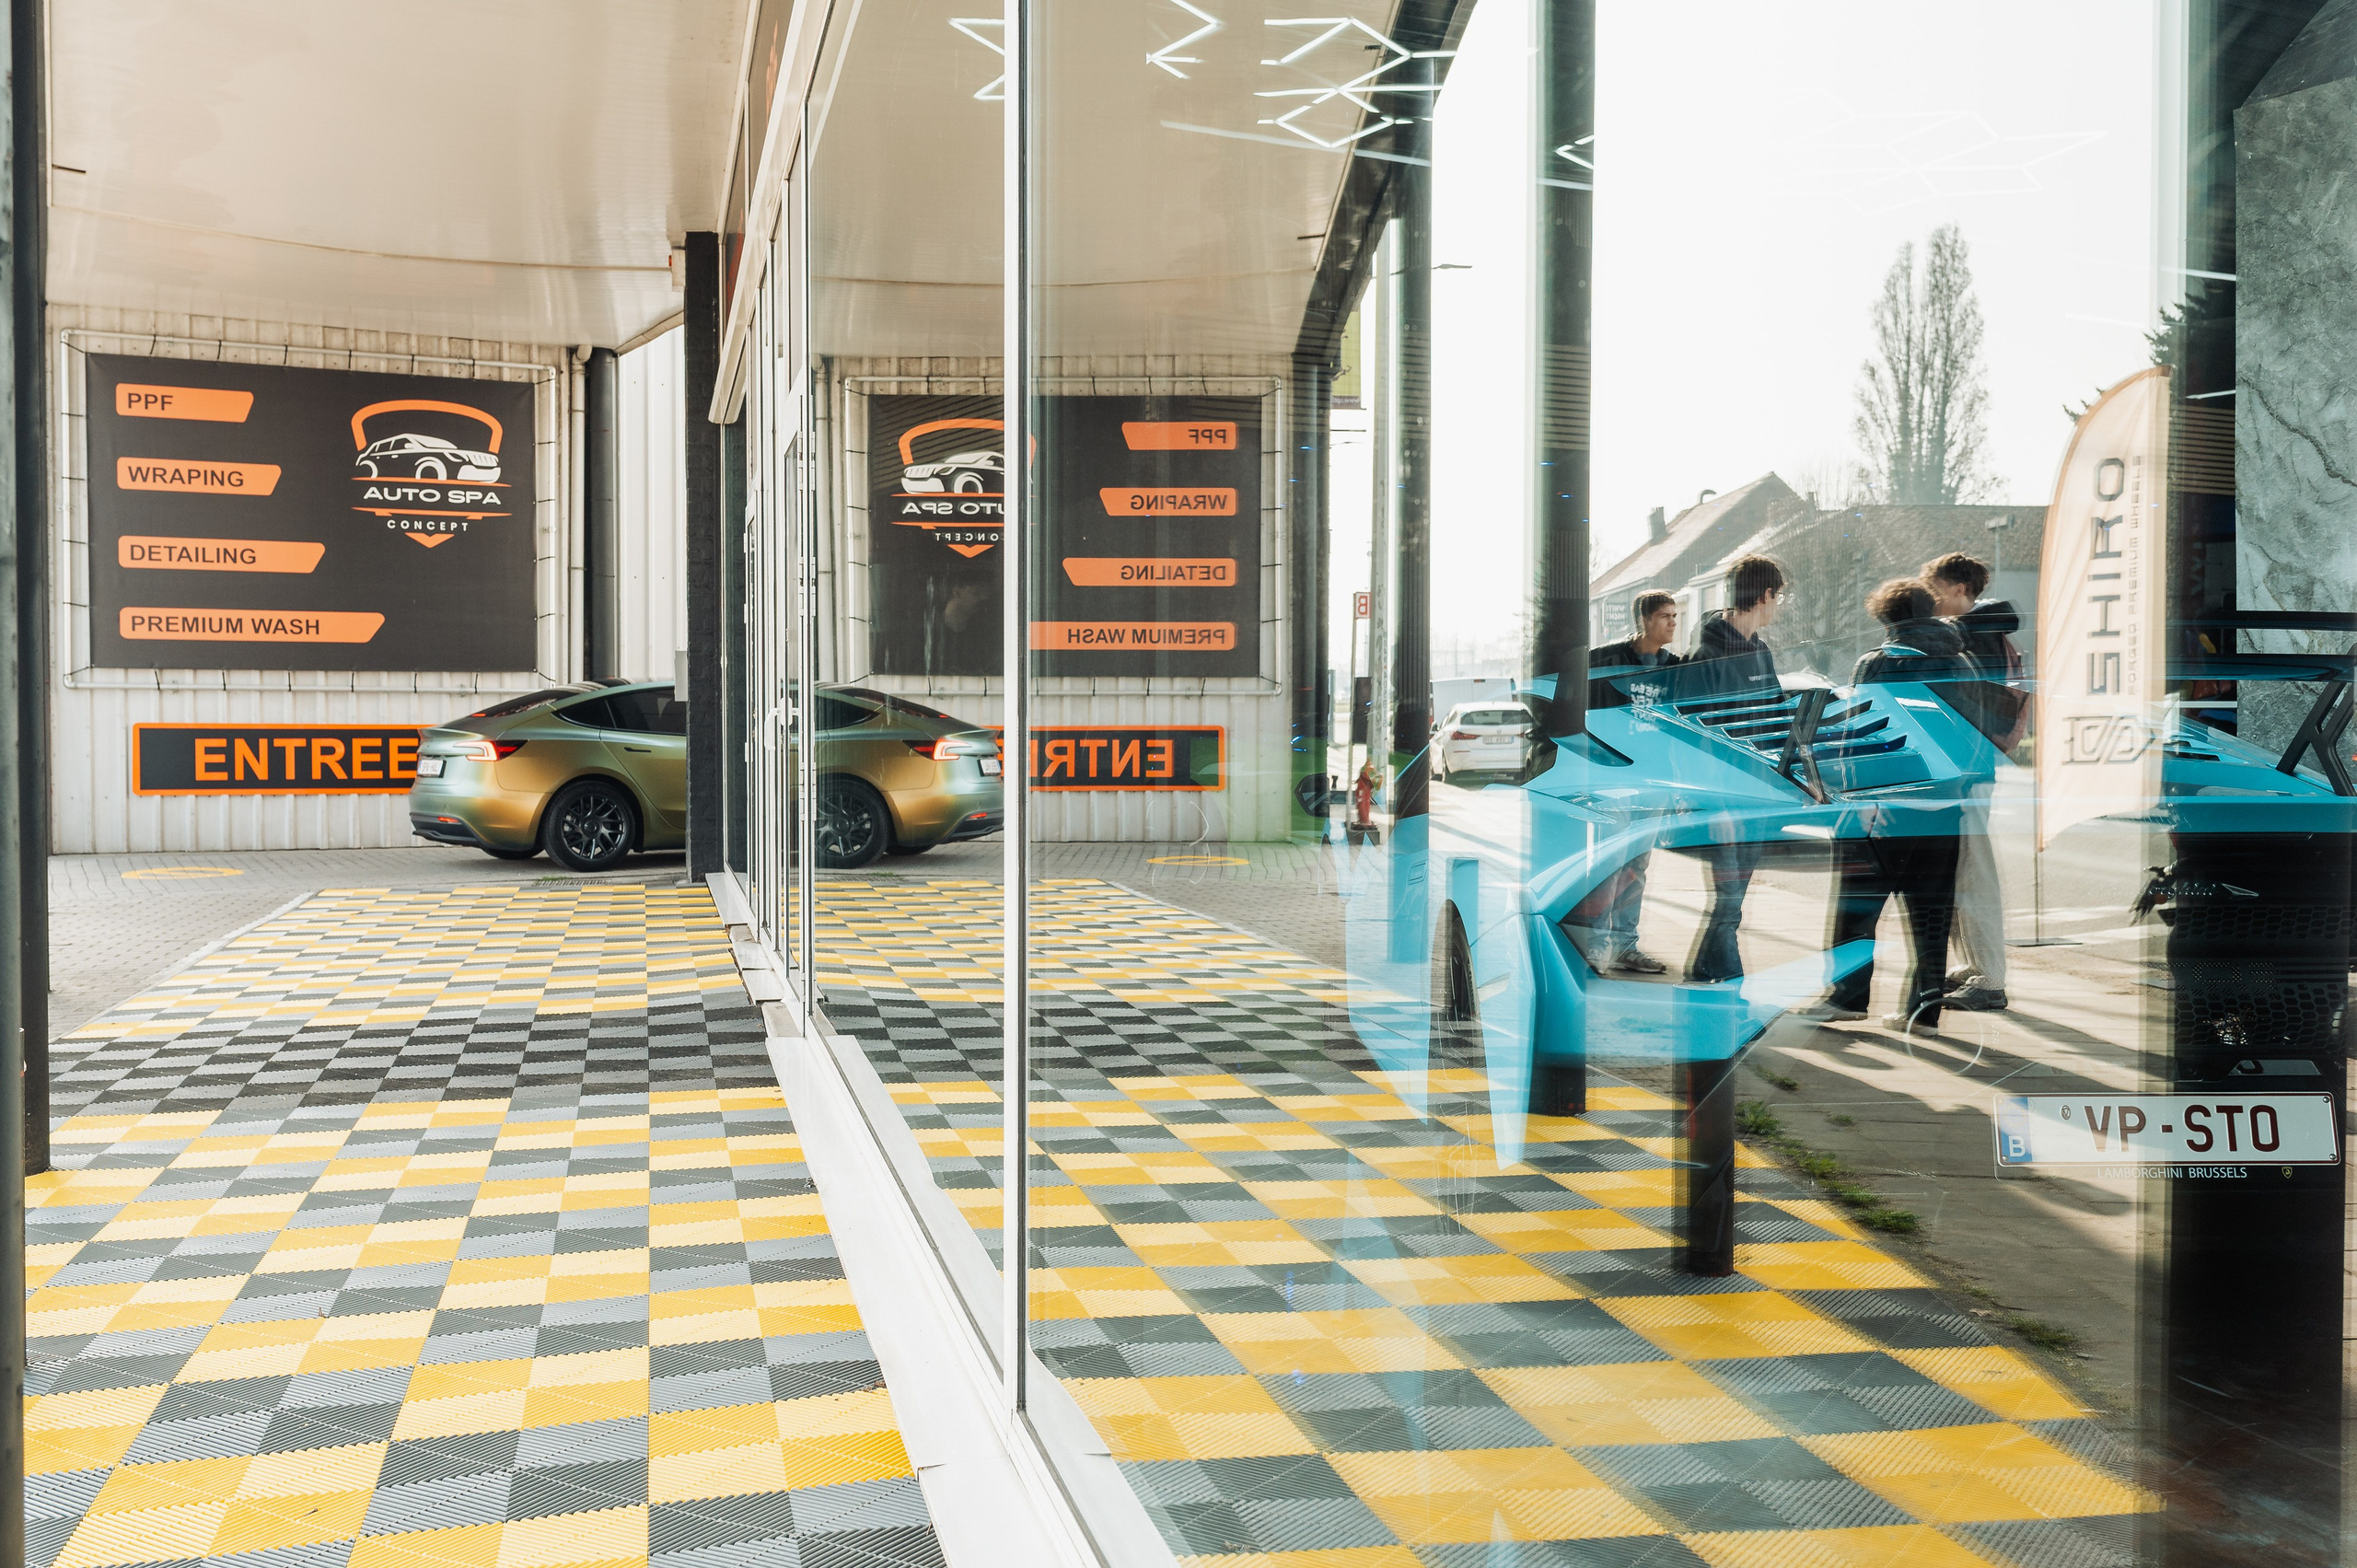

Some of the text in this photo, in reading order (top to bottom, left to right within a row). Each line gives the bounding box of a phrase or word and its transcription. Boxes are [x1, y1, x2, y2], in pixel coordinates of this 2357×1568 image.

[127, 392, 174, 411] PPF
[127, 466, 244, 487] WRAPING
[363, 486, 502, 505] AUTO SPA
[387, 519, 469, 531] CONCEPT
[130, 544, 257, 564] DETAILING
[2086, 457, 2126, 696] SHIRO
[2128, 537, 2140, 615] PREMIUM
[131, 615, 319, 635] PREMIUM WASH
[195, 738, 419, 781] ENTREE
[2009, 1135, 2026, 1157] B
[2097, 1167, 2247, 1179] LAMBORGHINI BRUSSELS
